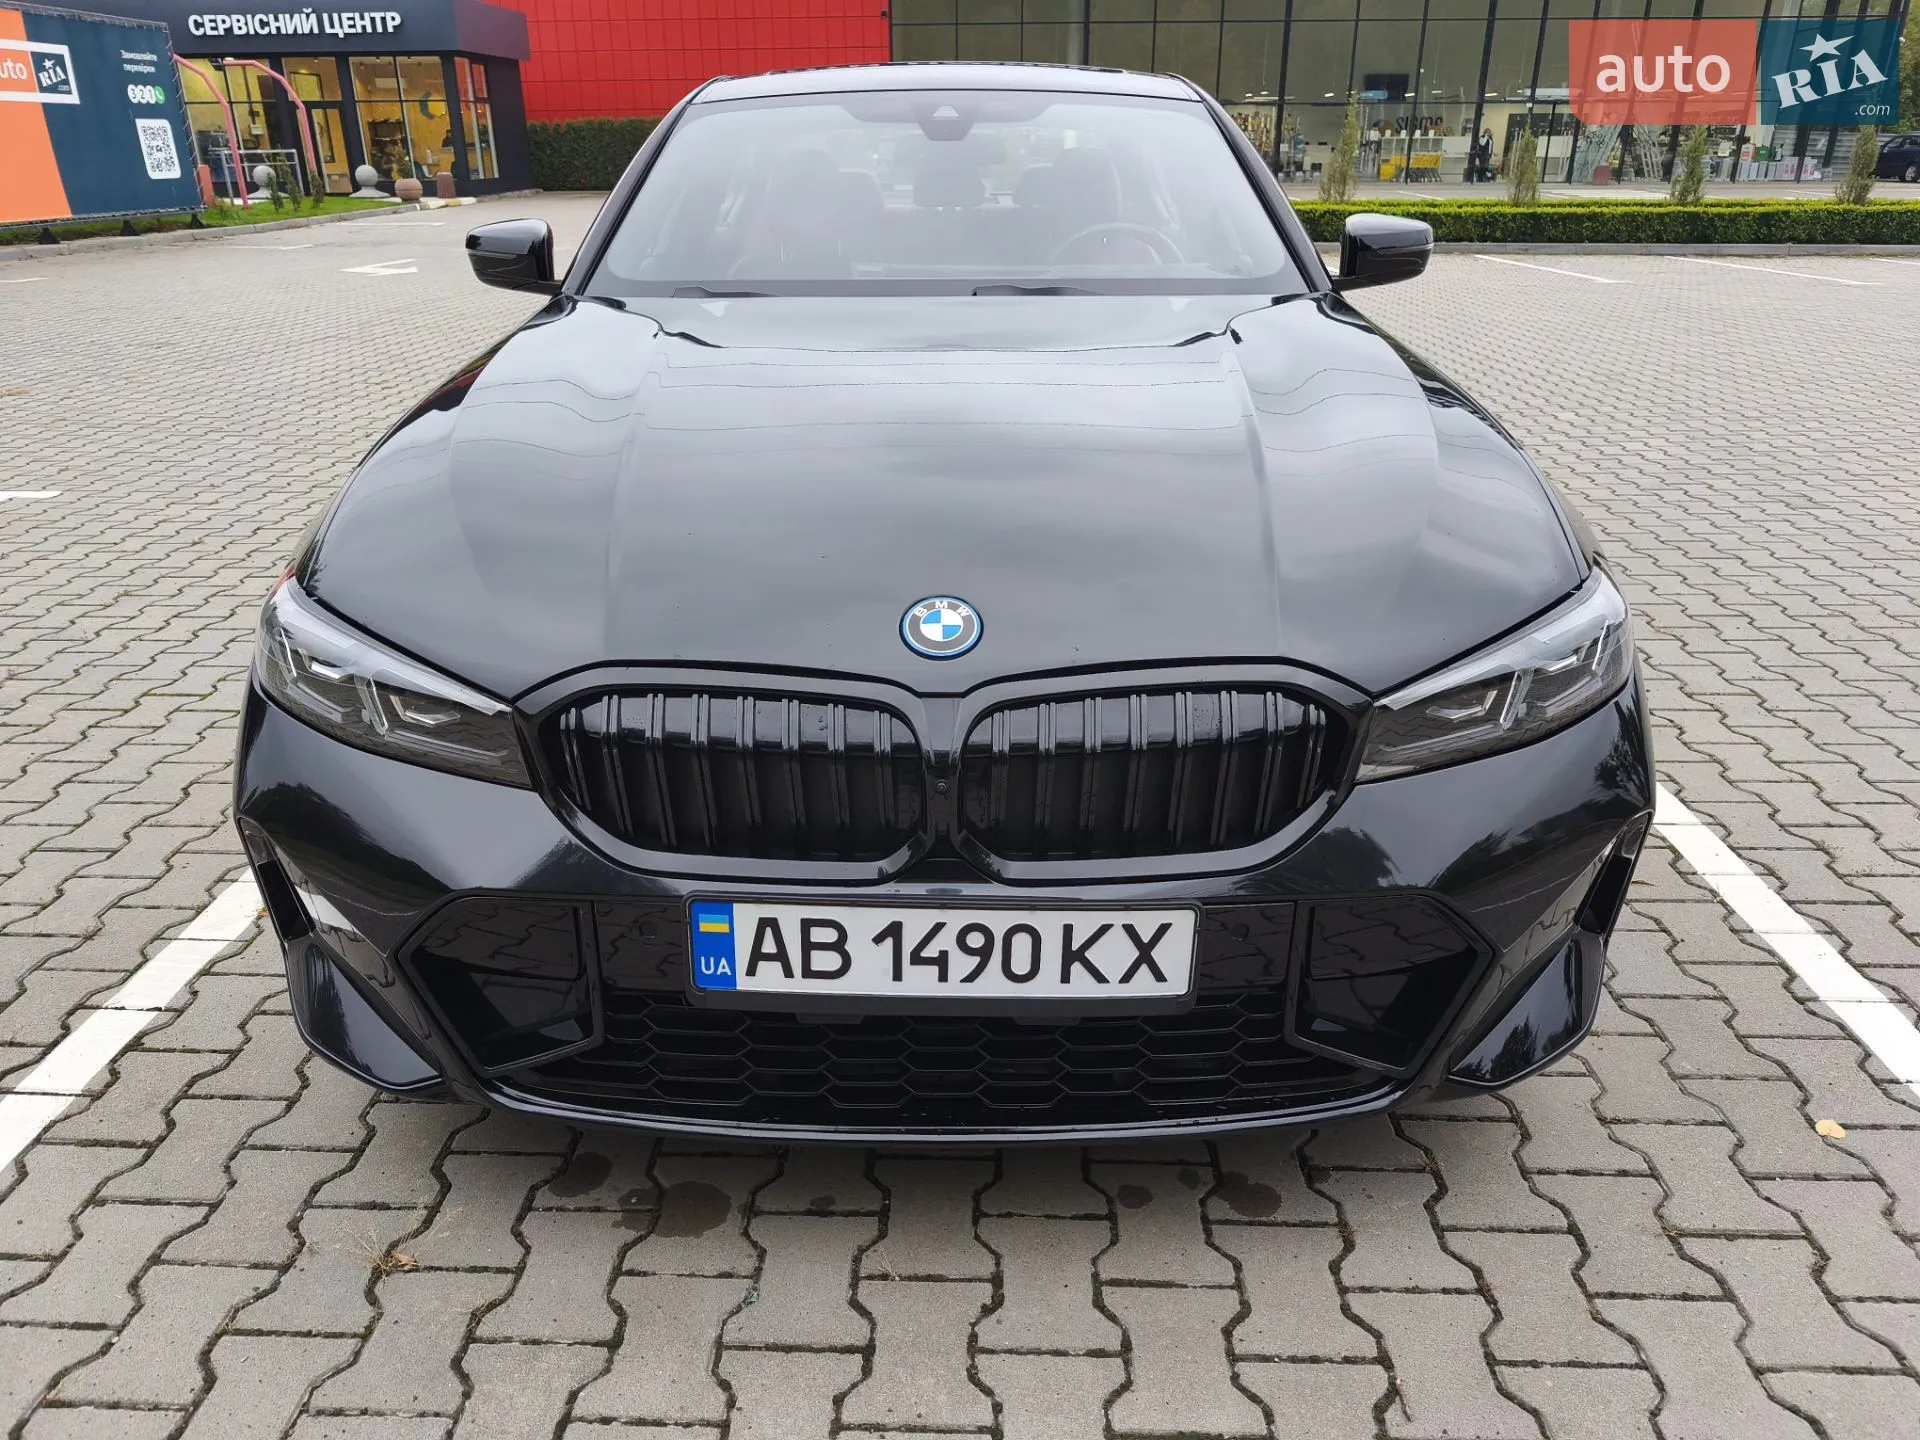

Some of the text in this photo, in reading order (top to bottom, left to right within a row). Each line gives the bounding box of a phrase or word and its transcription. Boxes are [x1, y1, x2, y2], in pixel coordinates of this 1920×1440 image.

[188, 7, 401, 38] СЕРВІСНИЙ ЦЕНТР
[0, 58, 28, 80] uto
[38, 65, 67, 87] RIA
[914, 600, 971, 618] BMW
[745, 917, 1173, 985] AB 1490 KX
[700, 955, 732, 977] UA
